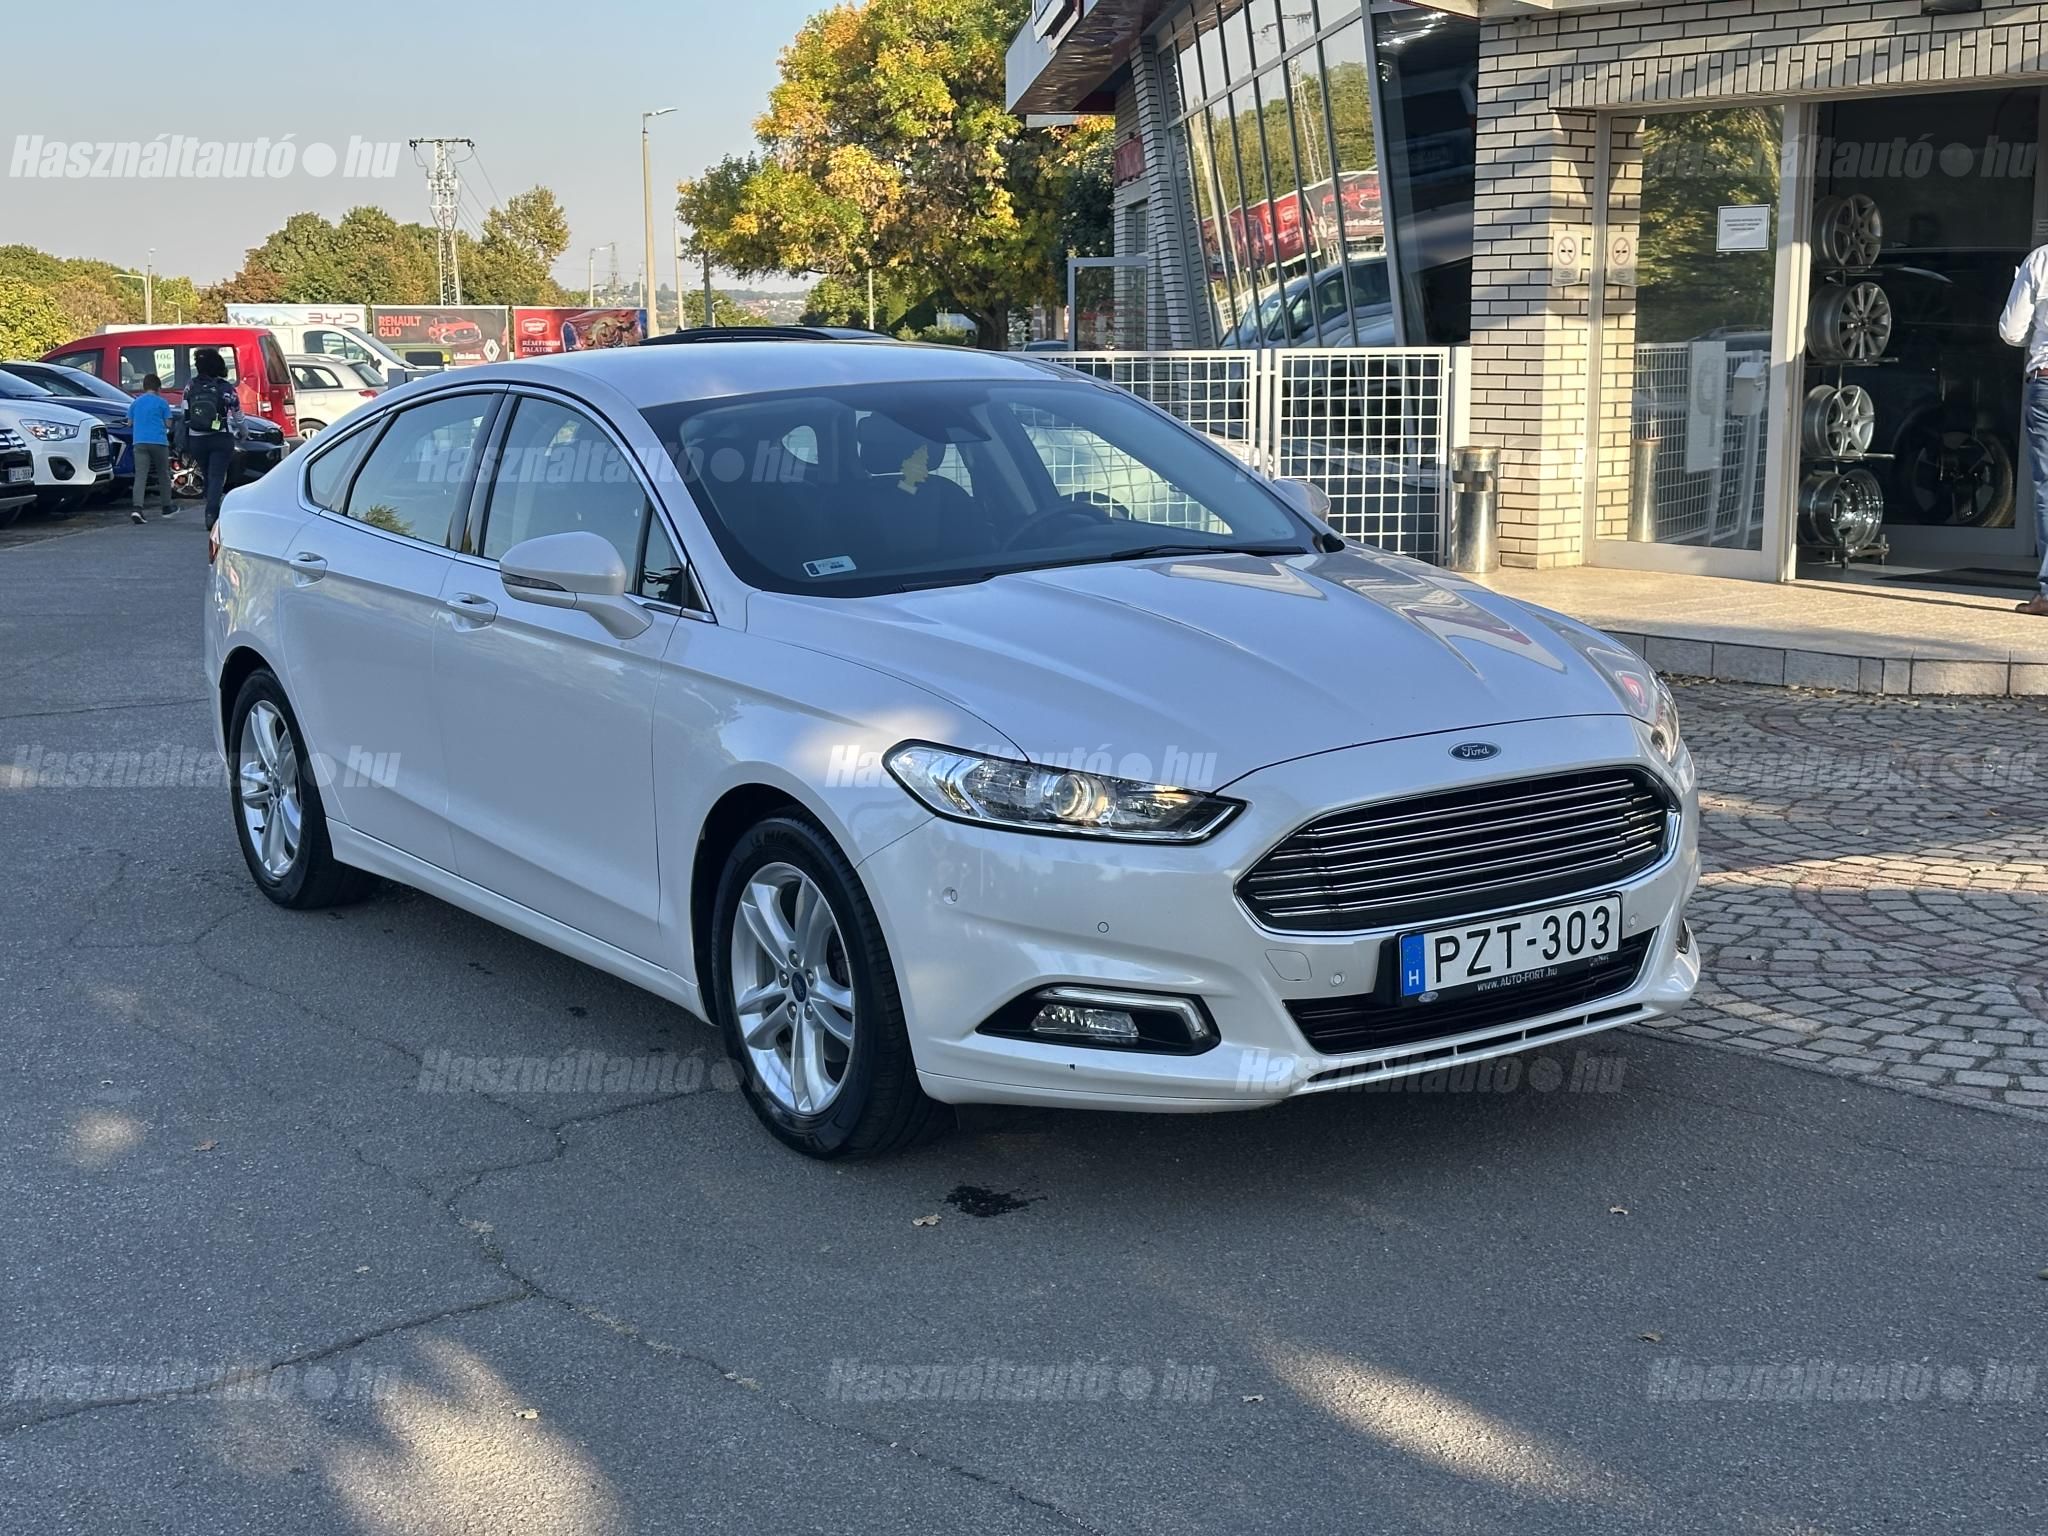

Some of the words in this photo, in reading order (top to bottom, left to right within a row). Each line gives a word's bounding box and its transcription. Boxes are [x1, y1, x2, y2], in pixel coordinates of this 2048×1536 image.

[308, 313, 360, 324] BYD
[378, 316, 422, 326] RENAULT
[379, 327, 401, 336] CLIO
[1434, 905, 1610, 983] PZT-303
[1408, 971, 1420, 987] H
